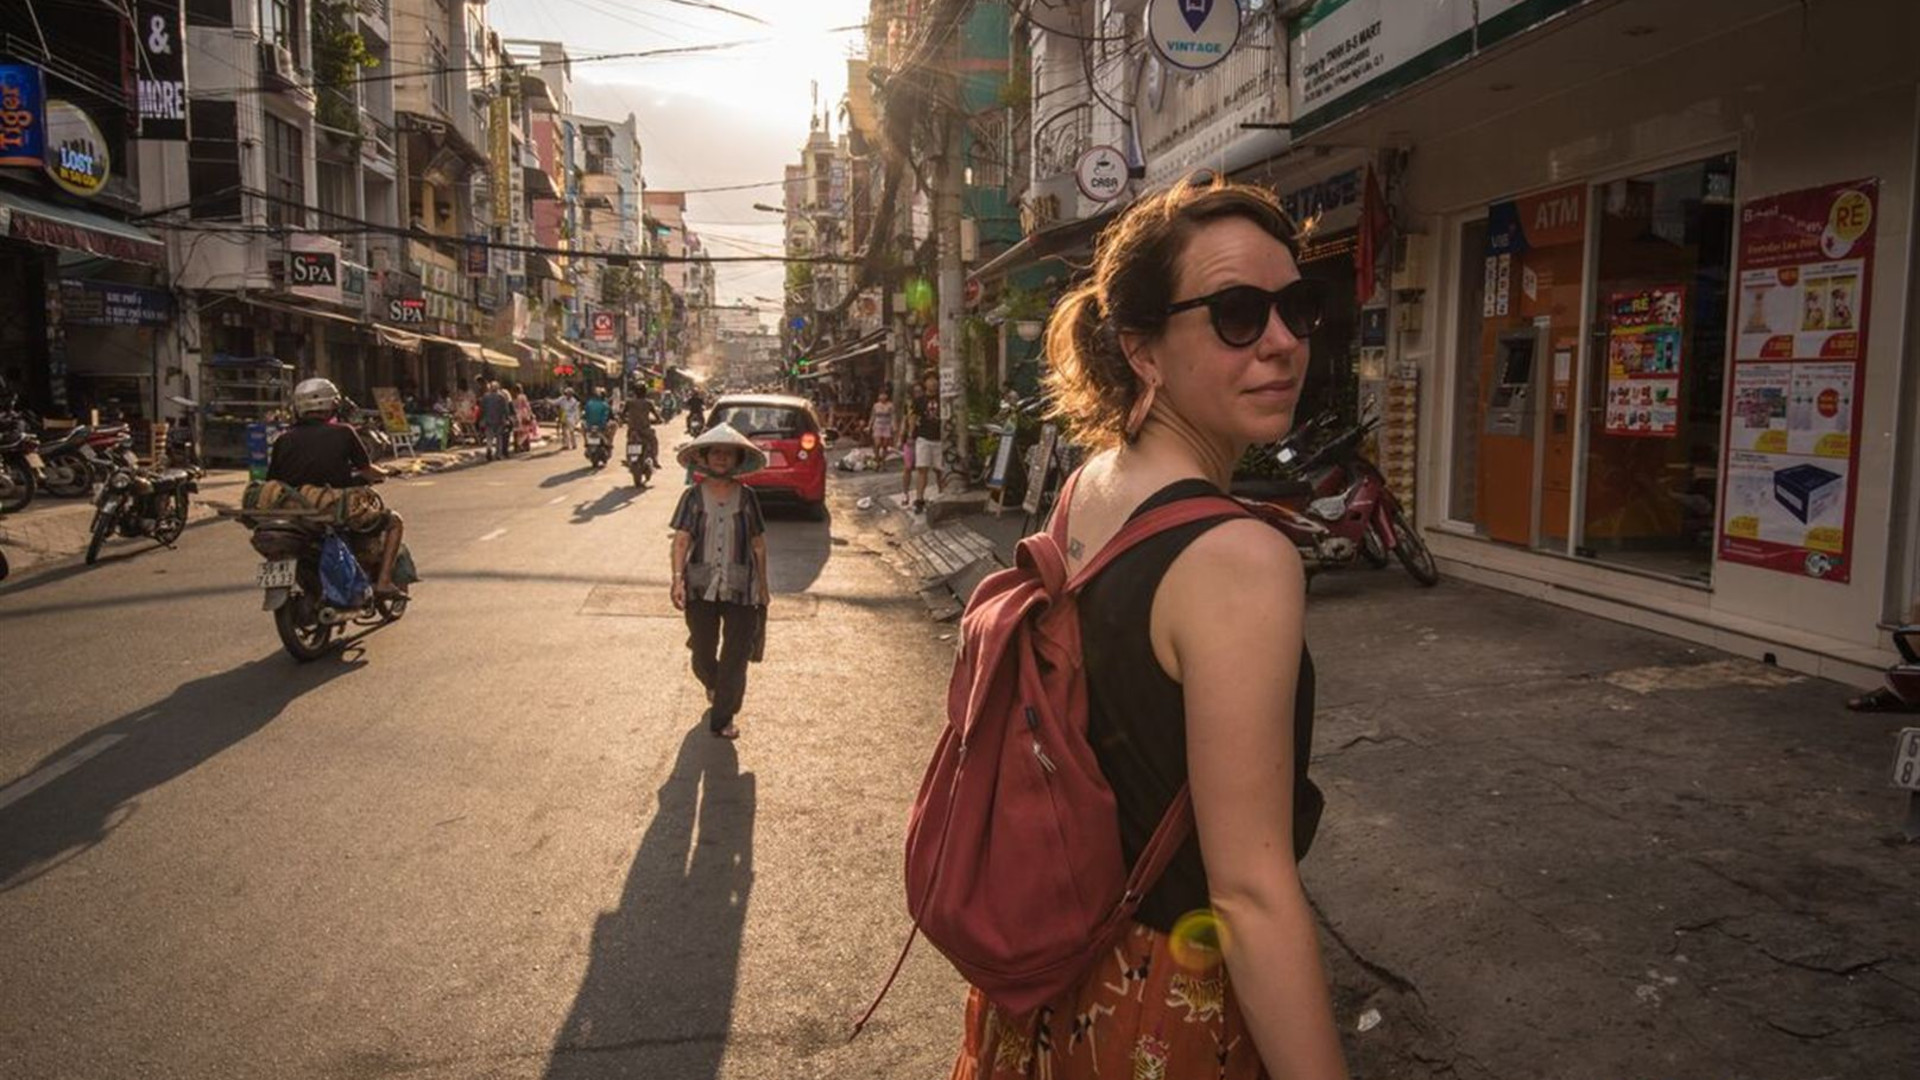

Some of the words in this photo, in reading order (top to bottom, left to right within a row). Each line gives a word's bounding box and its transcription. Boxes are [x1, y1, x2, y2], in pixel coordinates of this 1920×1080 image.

[148, 15, 172, 55] &
[1359, 20, 1382, 45] MART
[1167, 40, 1222, 54] VINTAGE
[138, 80, 185, 120] MORE
[60, 147, 94, 176] LOST
[1535, 195, 1580, 231] ATM
[294, 255, 333, 283] SPA
[390, 299, 424, 323] SPA
